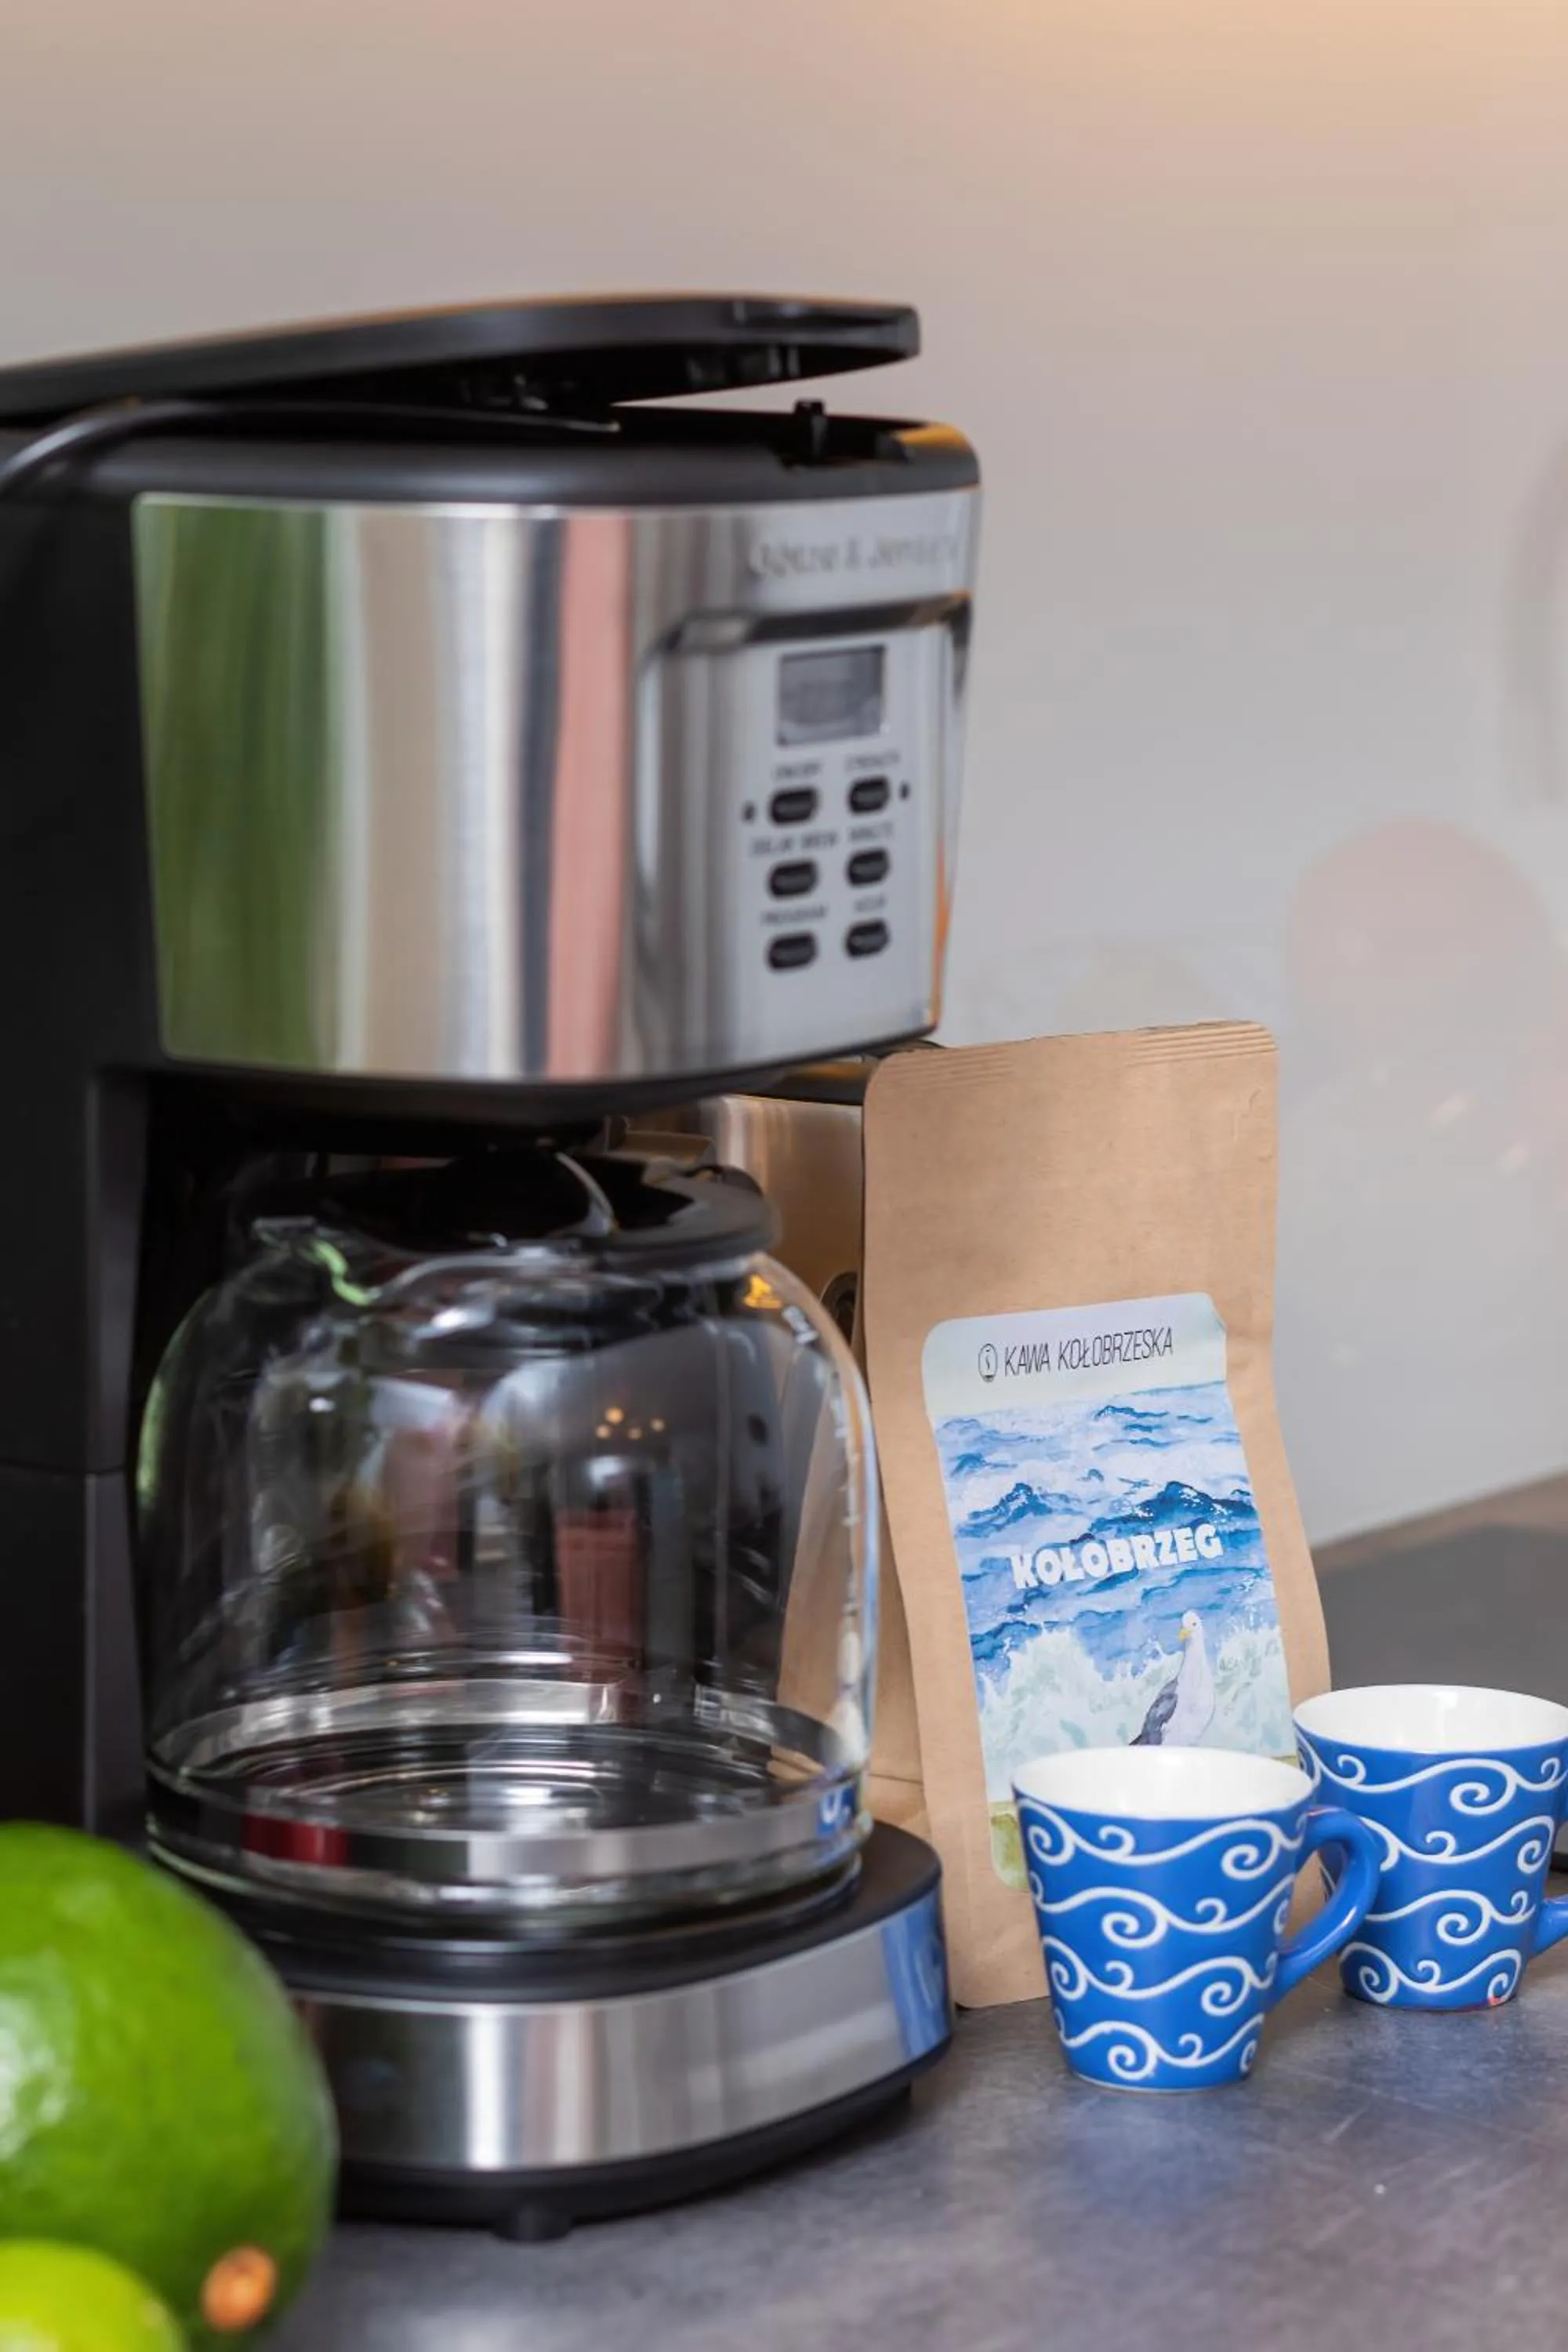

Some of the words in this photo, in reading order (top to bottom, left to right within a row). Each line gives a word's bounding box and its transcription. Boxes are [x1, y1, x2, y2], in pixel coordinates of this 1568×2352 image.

[1004, 1343, 1051, 1377] KAWA
[1058, 1327, 1173, 1371] KOŁOBRZESKA
[1011, 1523, 1224, 1588] KOŁOBRZEG
